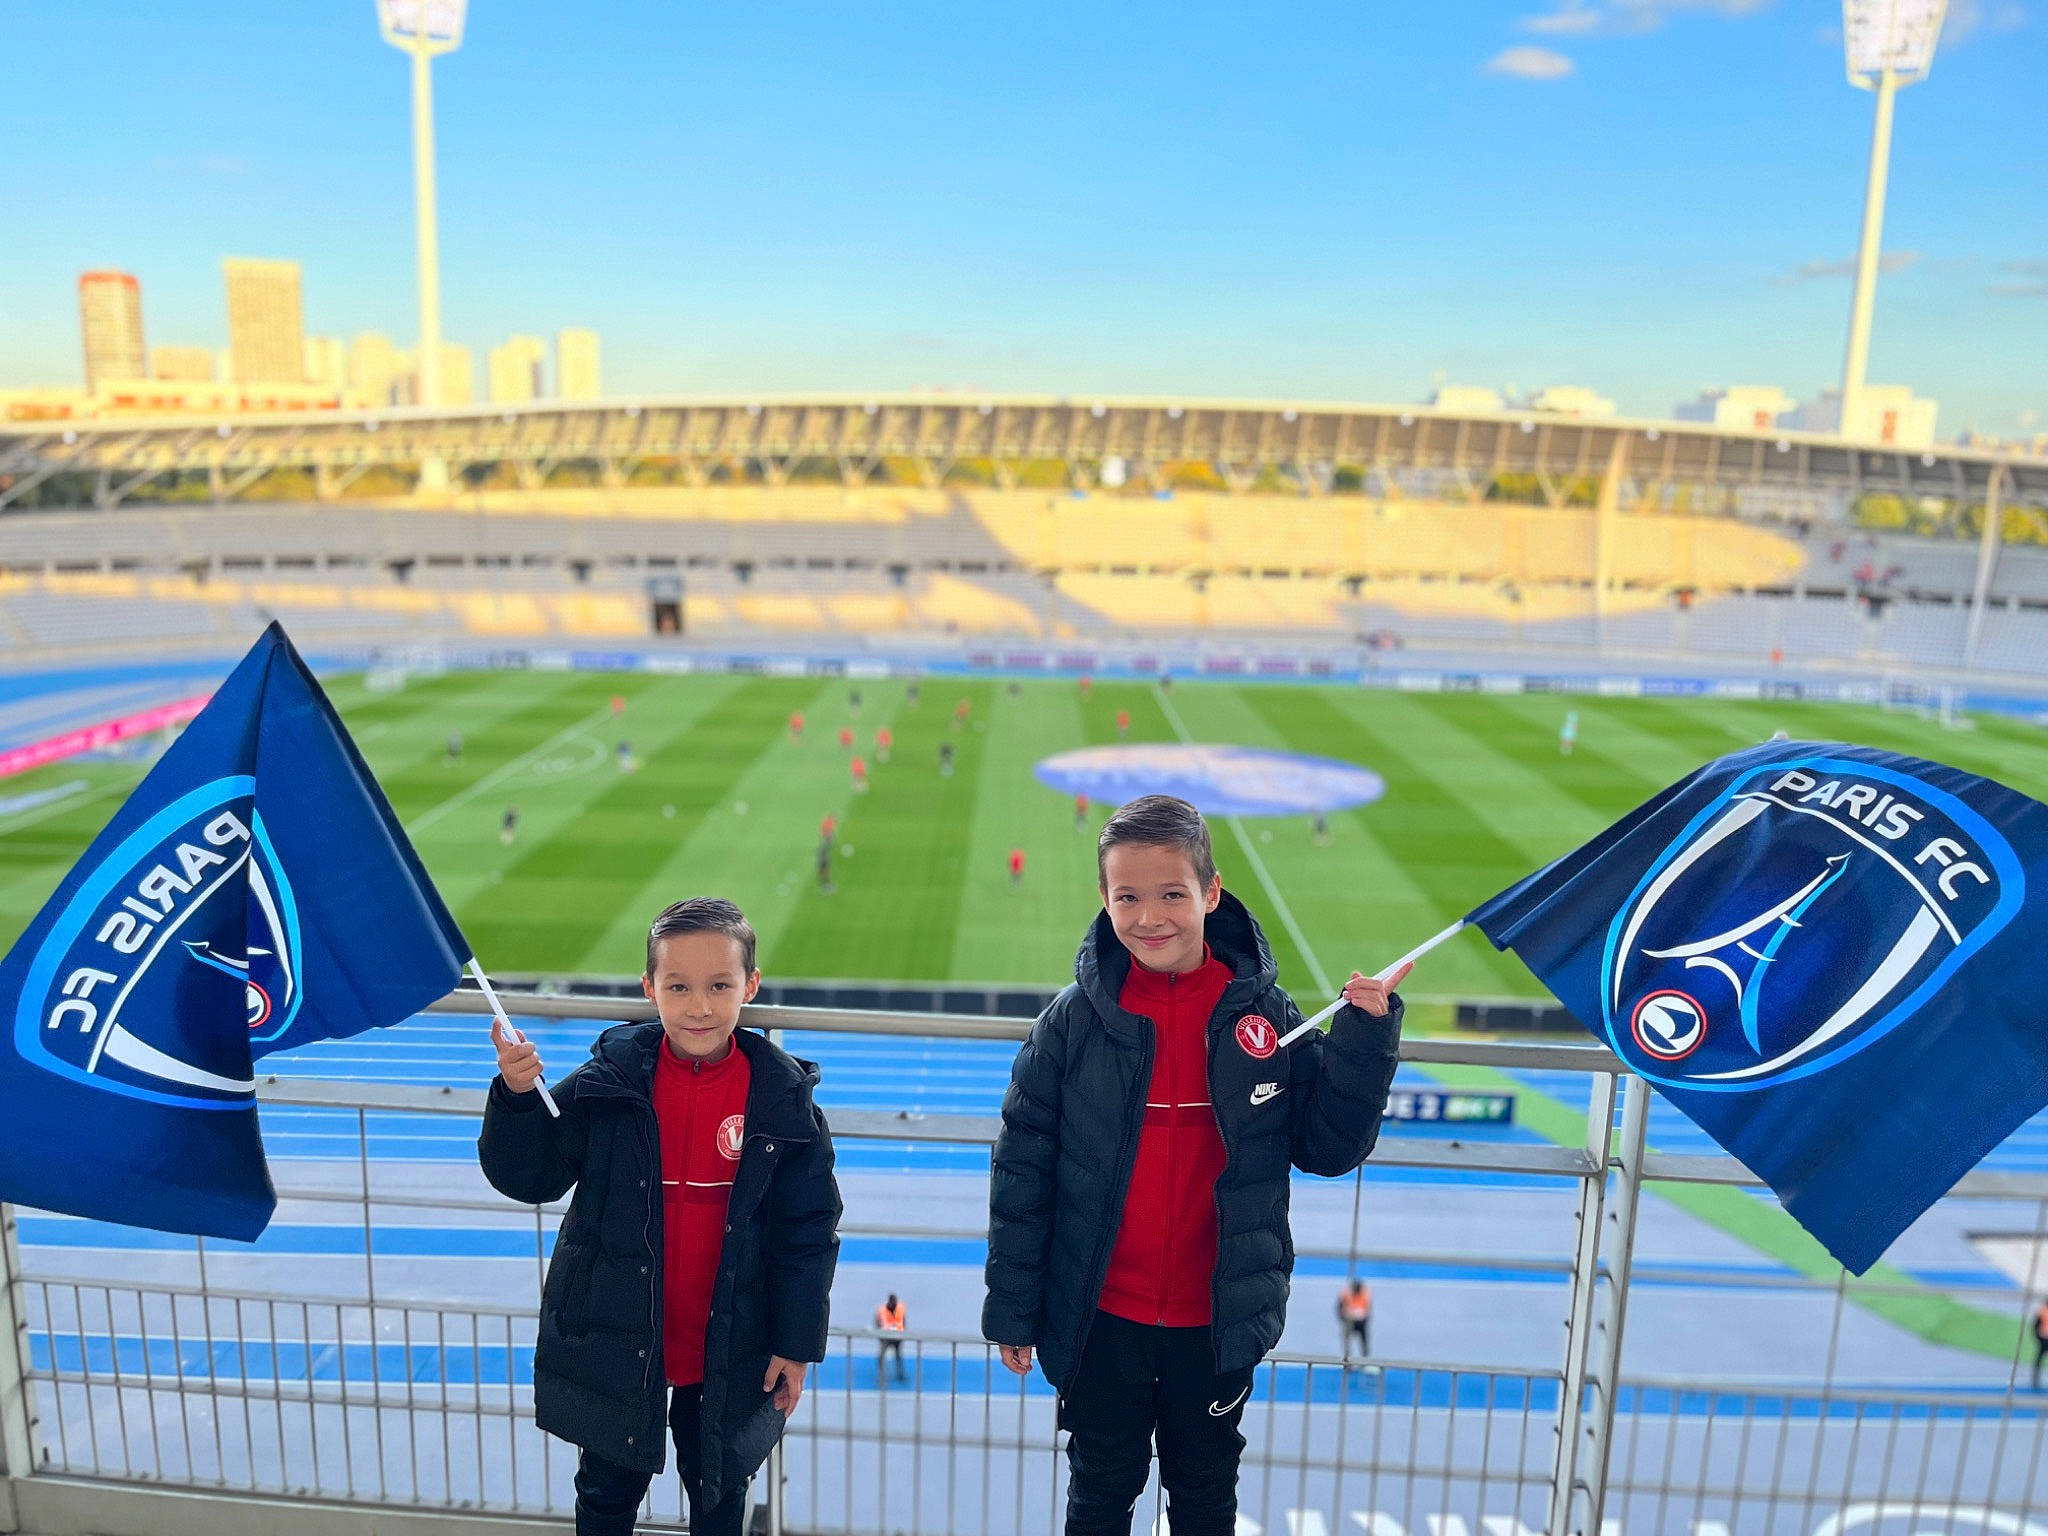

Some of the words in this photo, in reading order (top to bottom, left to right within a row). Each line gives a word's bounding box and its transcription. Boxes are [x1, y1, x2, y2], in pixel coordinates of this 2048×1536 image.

[1770, 770, 1925, 840] PARIS
[1914, 837, 1991, 901] FC
[1245, 1024, 1265, 1049] V
[1254, 1082, 1278, 1096] NIKE
